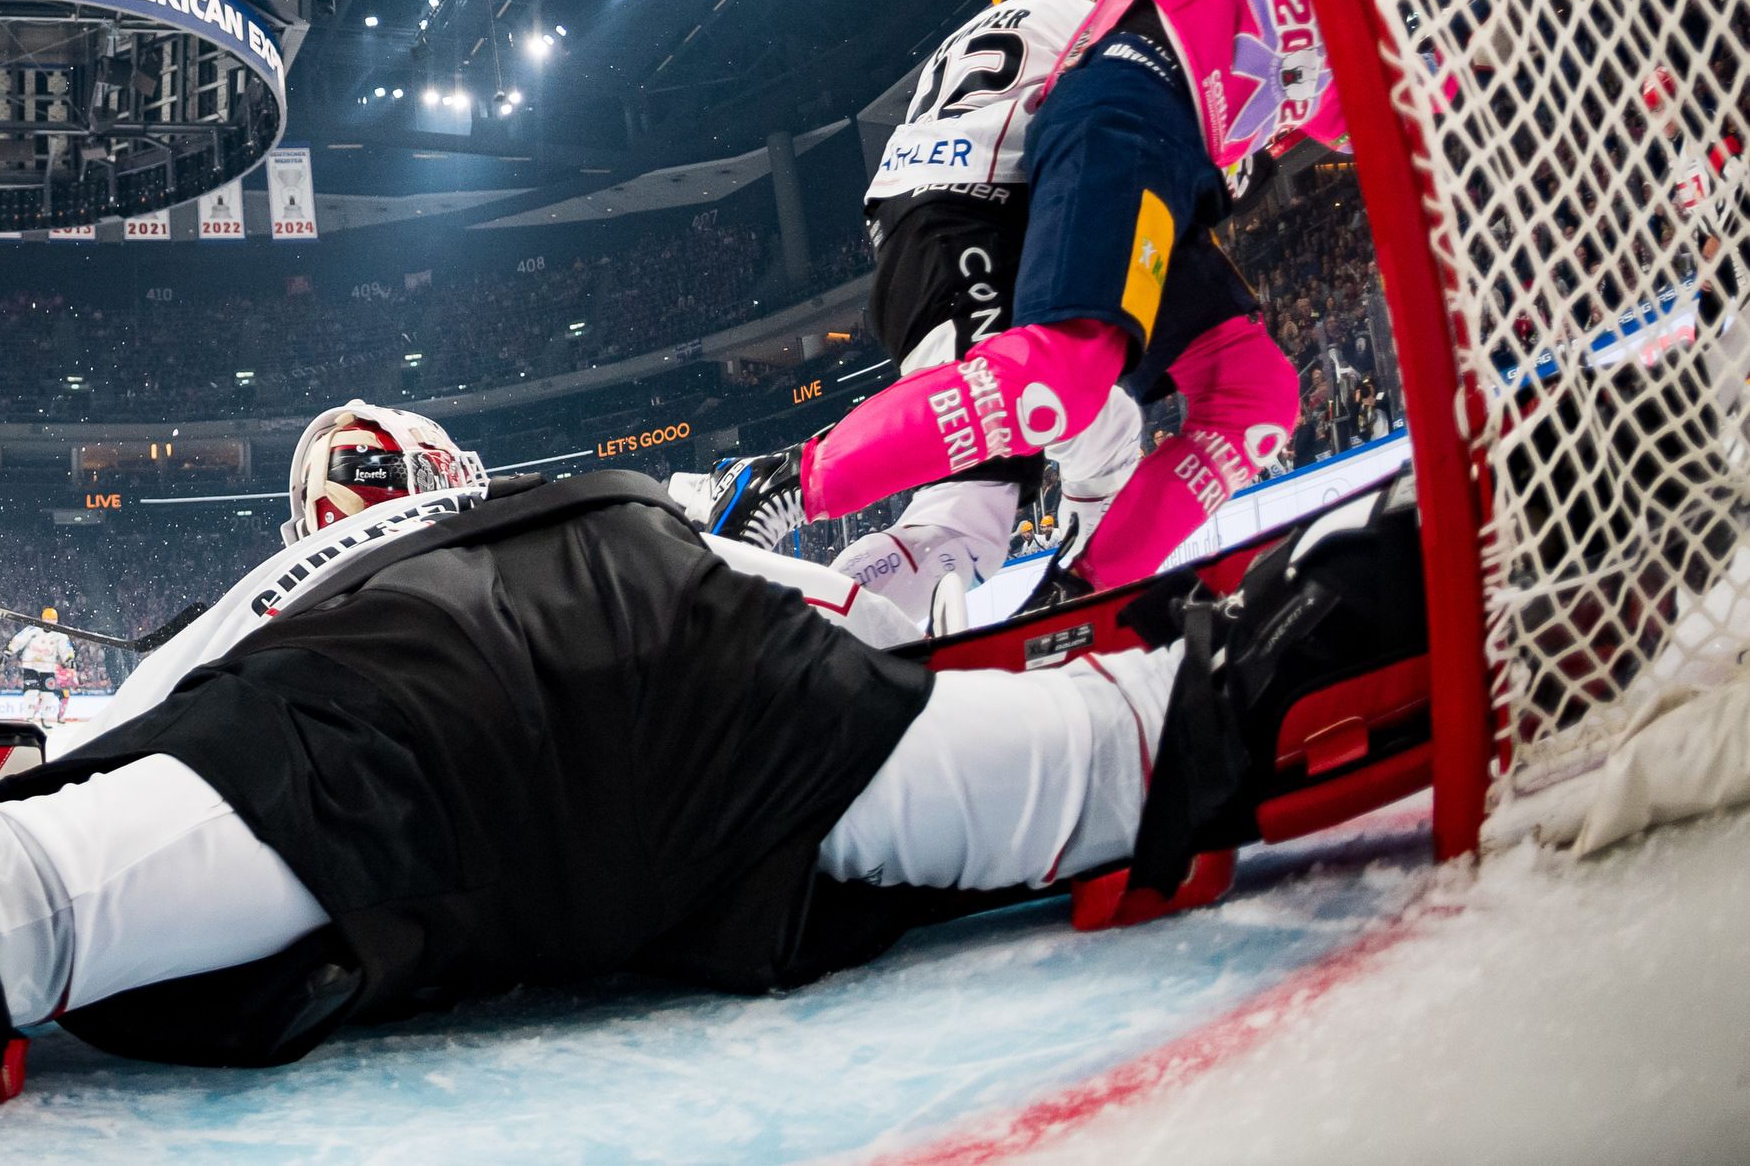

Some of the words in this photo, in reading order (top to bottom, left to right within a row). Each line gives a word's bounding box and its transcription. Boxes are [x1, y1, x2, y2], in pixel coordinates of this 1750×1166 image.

[127, 222, 167, 235] 2021
[202, 221, 242, 234] 2022
[274, 221, 315, 234] 2024
[516, 256, 546, 273] 408
[145, 287, 173, 302] 410
[792, 380, 823, 405] LIVE
[596, 435, 639, 459] LET'S
[639, 422, 691, 450] GOOO
[86, 493, 122, 509] LIVE
